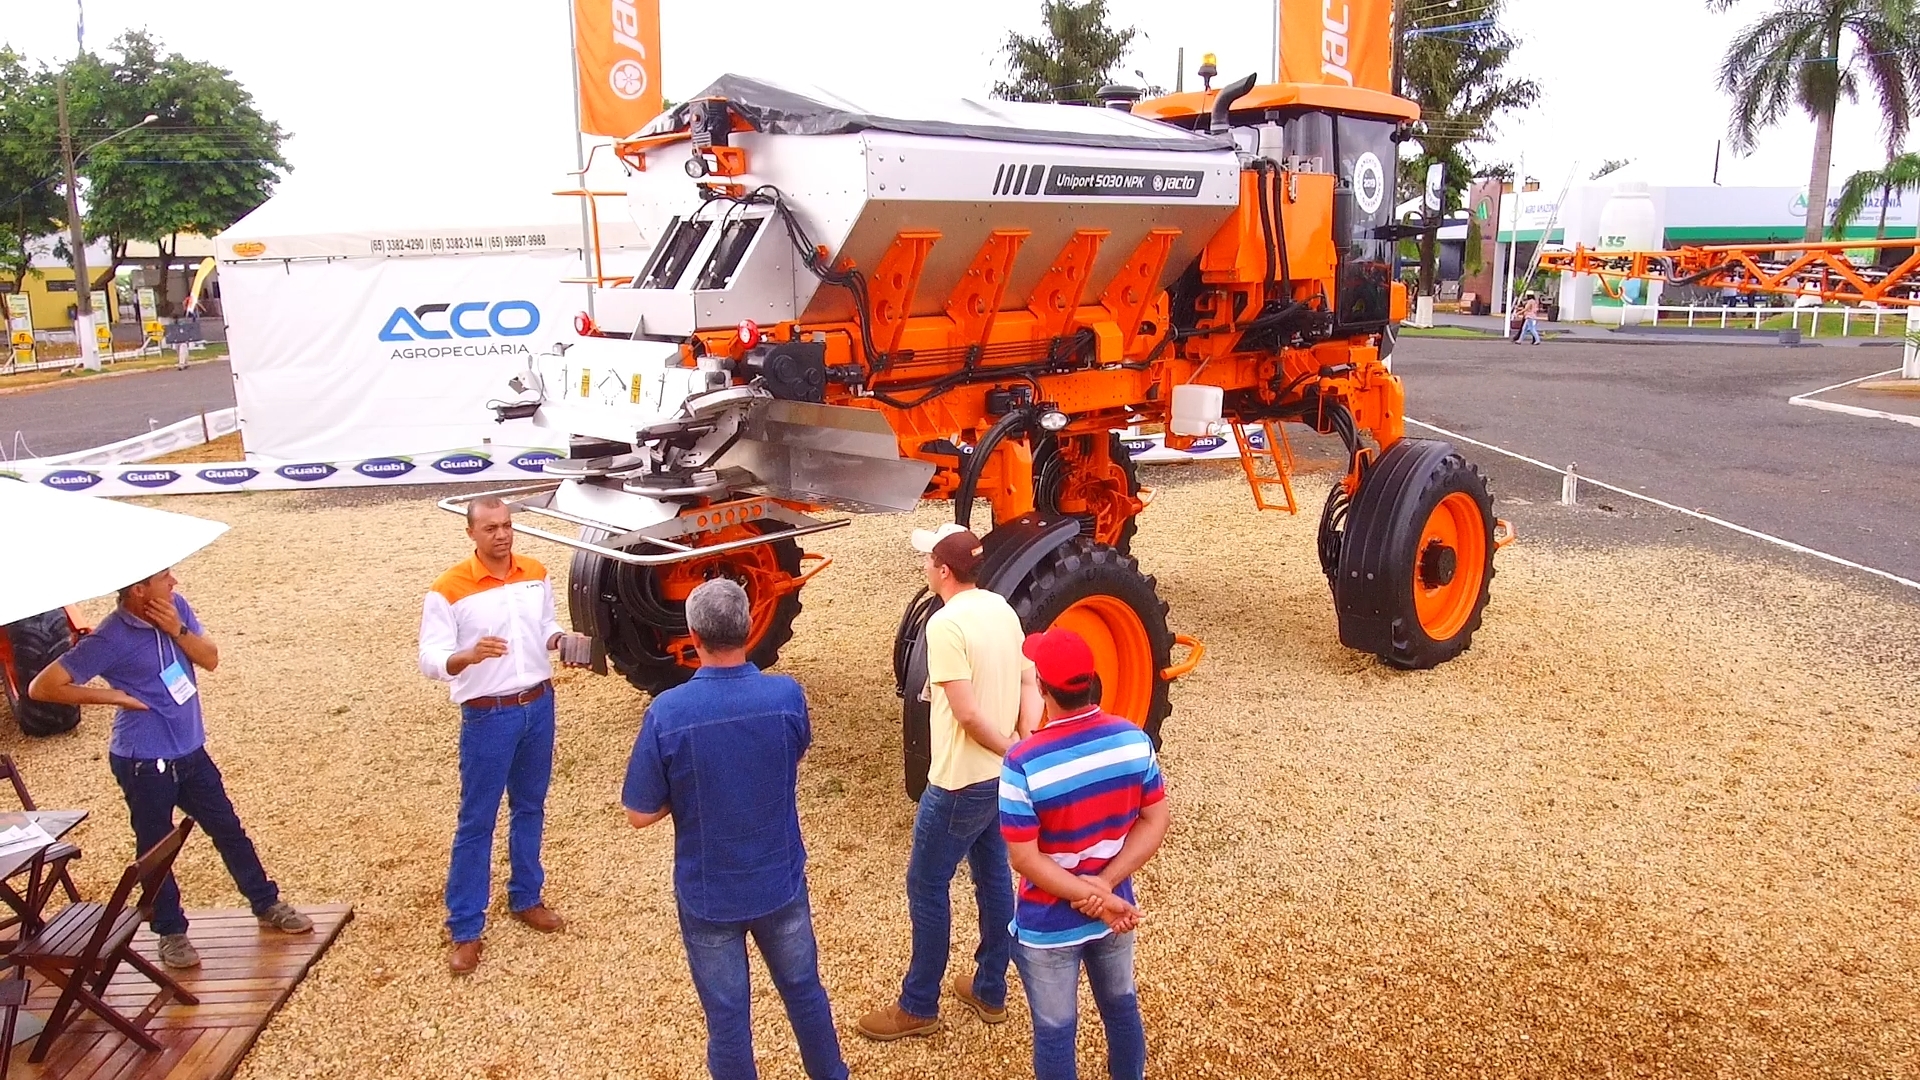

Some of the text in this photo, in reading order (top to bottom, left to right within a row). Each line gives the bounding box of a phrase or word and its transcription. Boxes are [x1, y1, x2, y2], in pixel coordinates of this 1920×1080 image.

[1321, 0, 1353, 88] jac
[1056, 173, 1144, 190] Uniport 5030 NPK
[370, 239, 385, 254] (65)
[387, 238, 424, 251] 3382-4290
[429, 238, 445, 253] (65)
[446, 236, 483, 249] 3382-3144
[488, 236, 504, 251] (65)
[505, 234, 547, 247] 99987-9988
[1605, 235, 1627, 248] 35
[378, 300, 541, 342] ACCO
[390, 343, 530, 360] AGROPECUÁRIA
[440, 459, 483, 470] Guabi
[517, 457, 559, 466] Guab
[283, 465, 328, 476] Guabi
[362, 462, 405, 473] Guabi
[126, 471, 170, 482] Guabi
[204, 468, 249, 479] Guabi
[49, 474, 92, 485] Guabi
